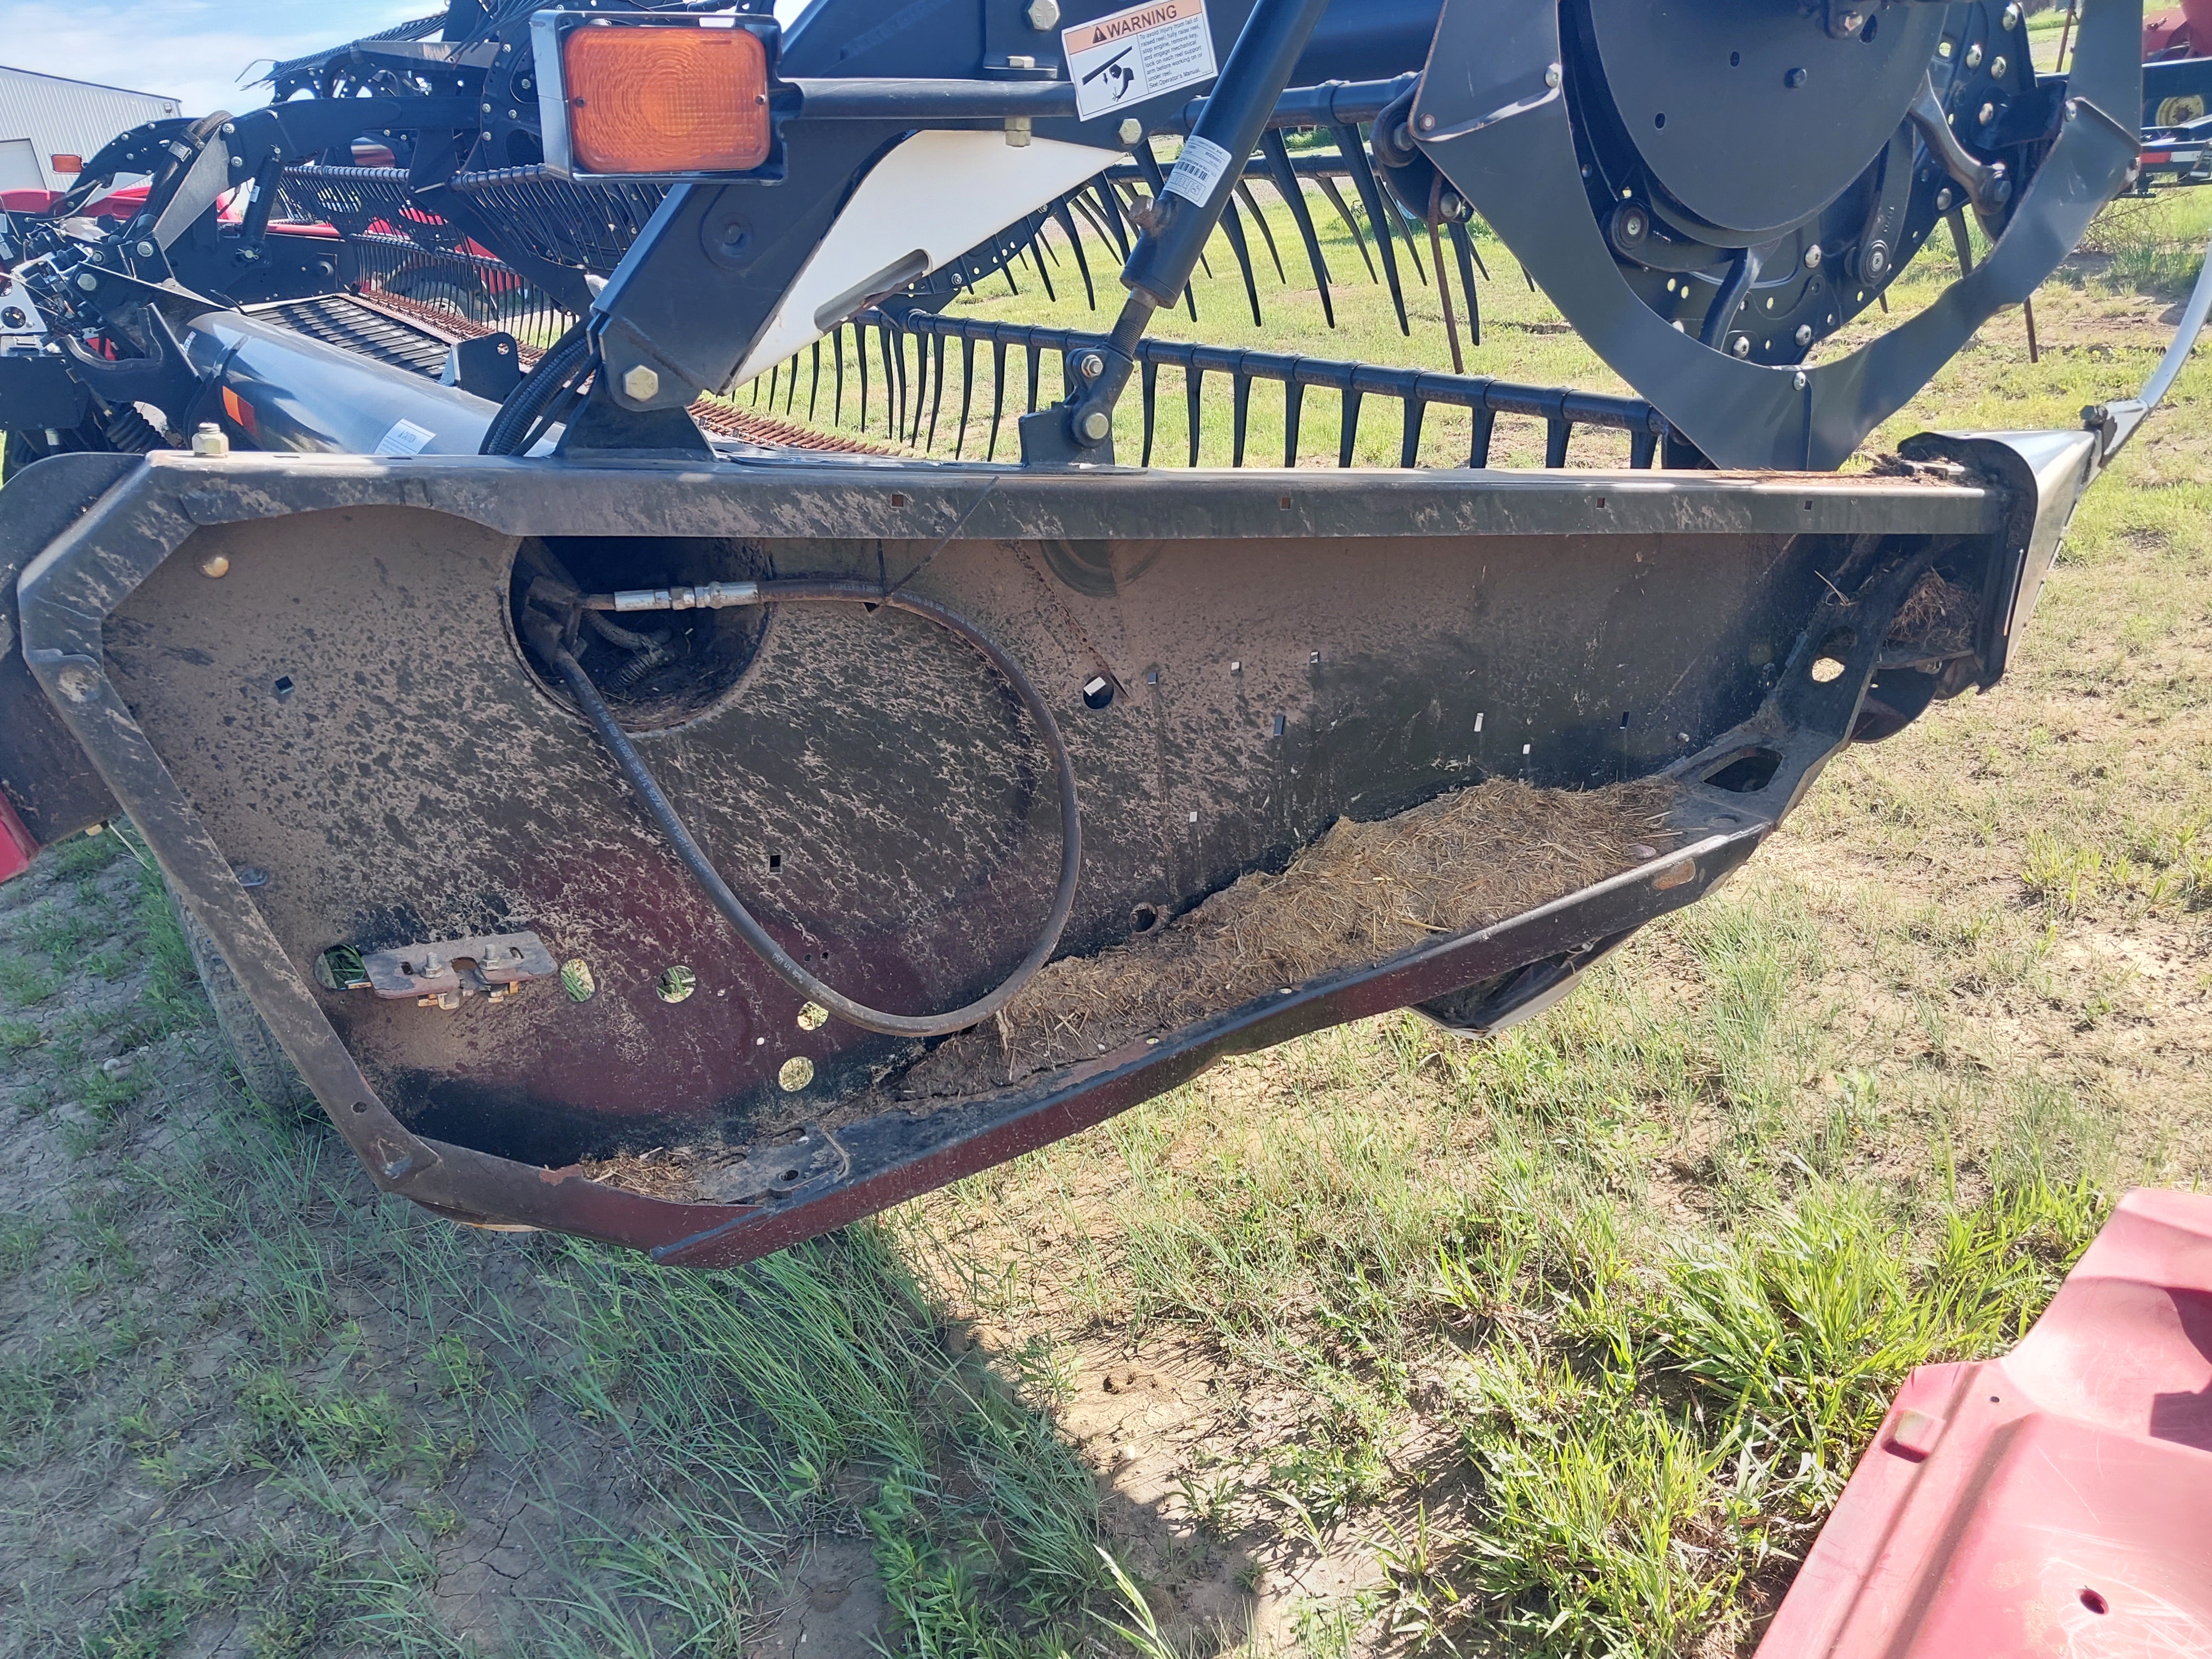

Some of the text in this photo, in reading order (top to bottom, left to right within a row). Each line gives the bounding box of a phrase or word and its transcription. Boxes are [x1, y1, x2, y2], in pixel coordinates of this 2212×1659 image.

[1105, 4, 1178, 38] WARNING
[1145, 29, 1159, 37] avoid
[1159, 25, 1173, 34] injury
[1140, 38, 1155, 47] raised
[1167, 31, 1178, 39] fully
[1142, 47, 1153, 55] stop
[1171, 36, 1188, 44] remove
[1153, 49, 1171, 59] engage
[1170, 40, 1197, 52] mechanical
[1184, 46, 1202, 55] support
[1156, 62, 1171, 71] before
[1172, 56, 1190, 67] working
[1147, 73, 1161, 81] under
[1158, 73, 1182, 86] Operator's
[770, 951, 784, 965] USA
